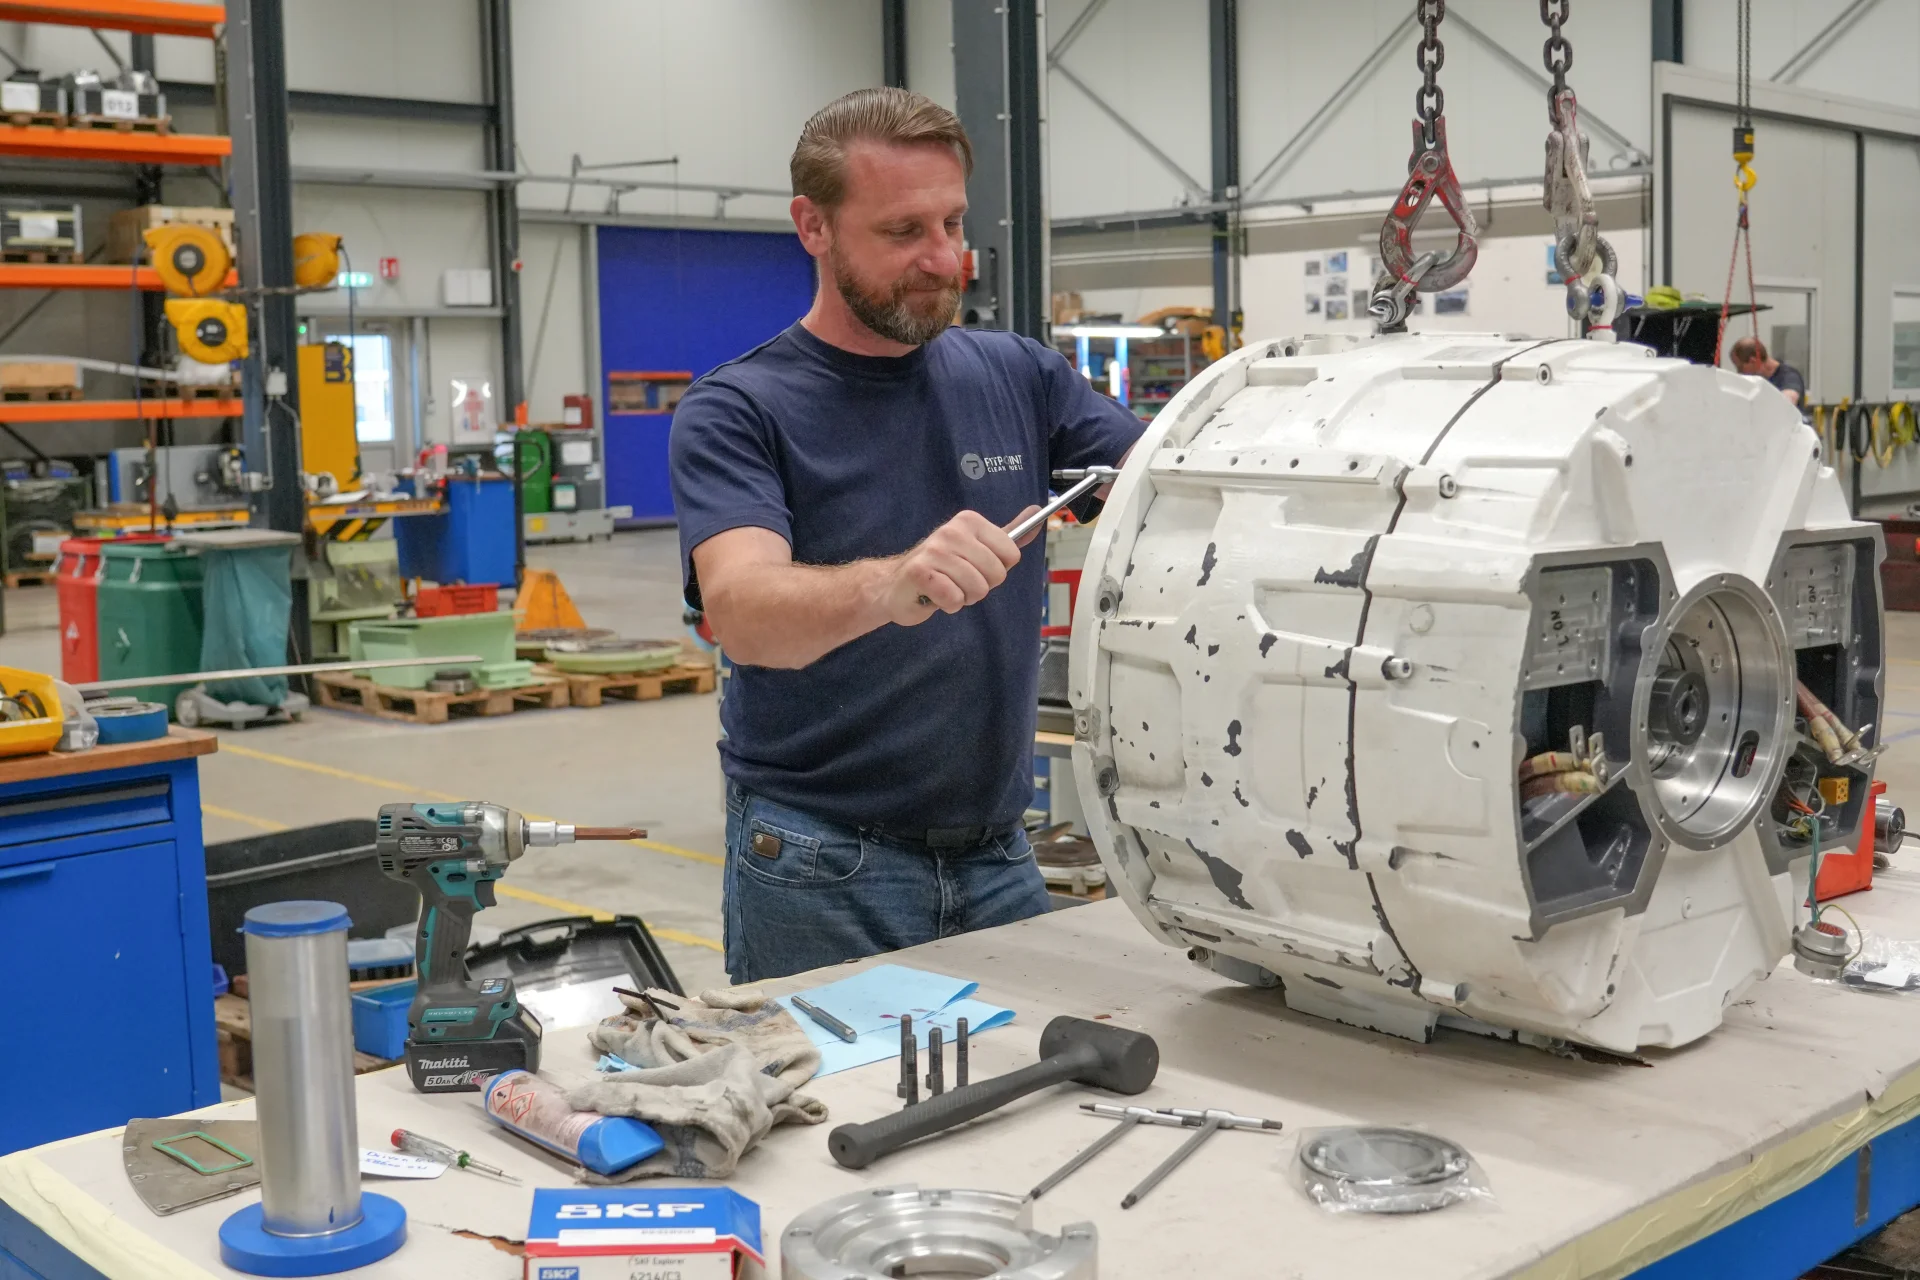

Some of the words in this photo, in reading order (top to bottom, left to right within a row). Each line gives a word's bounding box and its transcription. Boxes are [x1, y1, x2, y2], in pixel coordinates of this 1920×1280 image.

[427, 1077, 451, 1085] 5.0Ah
[556, 1203, 705, 1219] SKF
[541, 1268, 578, 1279] SKF
